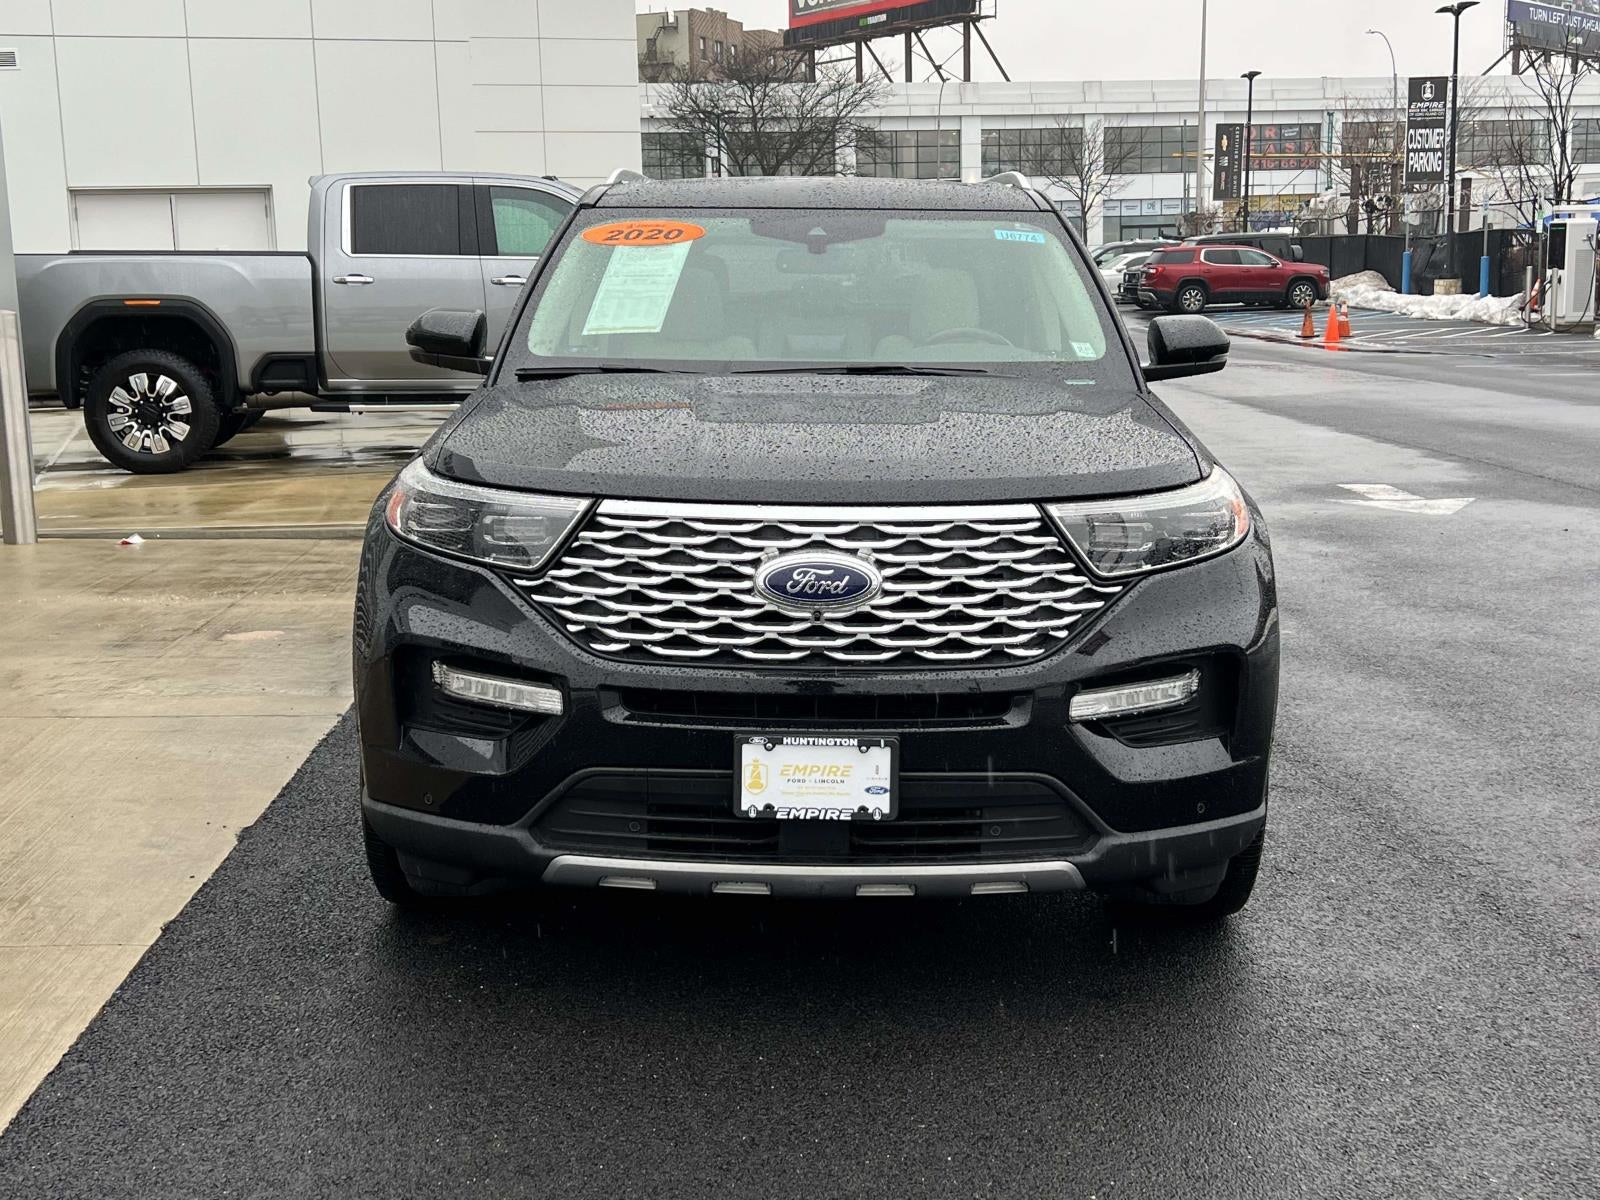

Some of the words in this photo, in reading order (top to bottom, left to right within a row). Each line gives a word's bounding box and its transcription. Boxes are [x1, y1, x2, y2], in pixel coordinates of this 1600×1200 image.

[1529, 8, 1548, 22] TURN
[1548, 12, 1566, 25] LEFT
[1565, 15, 1581, 28] JUST
[1582, 18, 1600, 32] AHEA
[1411, 101, 1445, 109] EMPIRE
[1408, 128, 1444, 149] CUSTOMER
[1408, 151, 1442, 173] PARKING
[602, 228, 684, 241] 2020
[786, 568, 850, 594] Ford
[783, 737, 858, 746] HUNTINGTON
[779, 764, 854, 777] EMPIRE
[776, 807, 856, 820] EMPIRE
